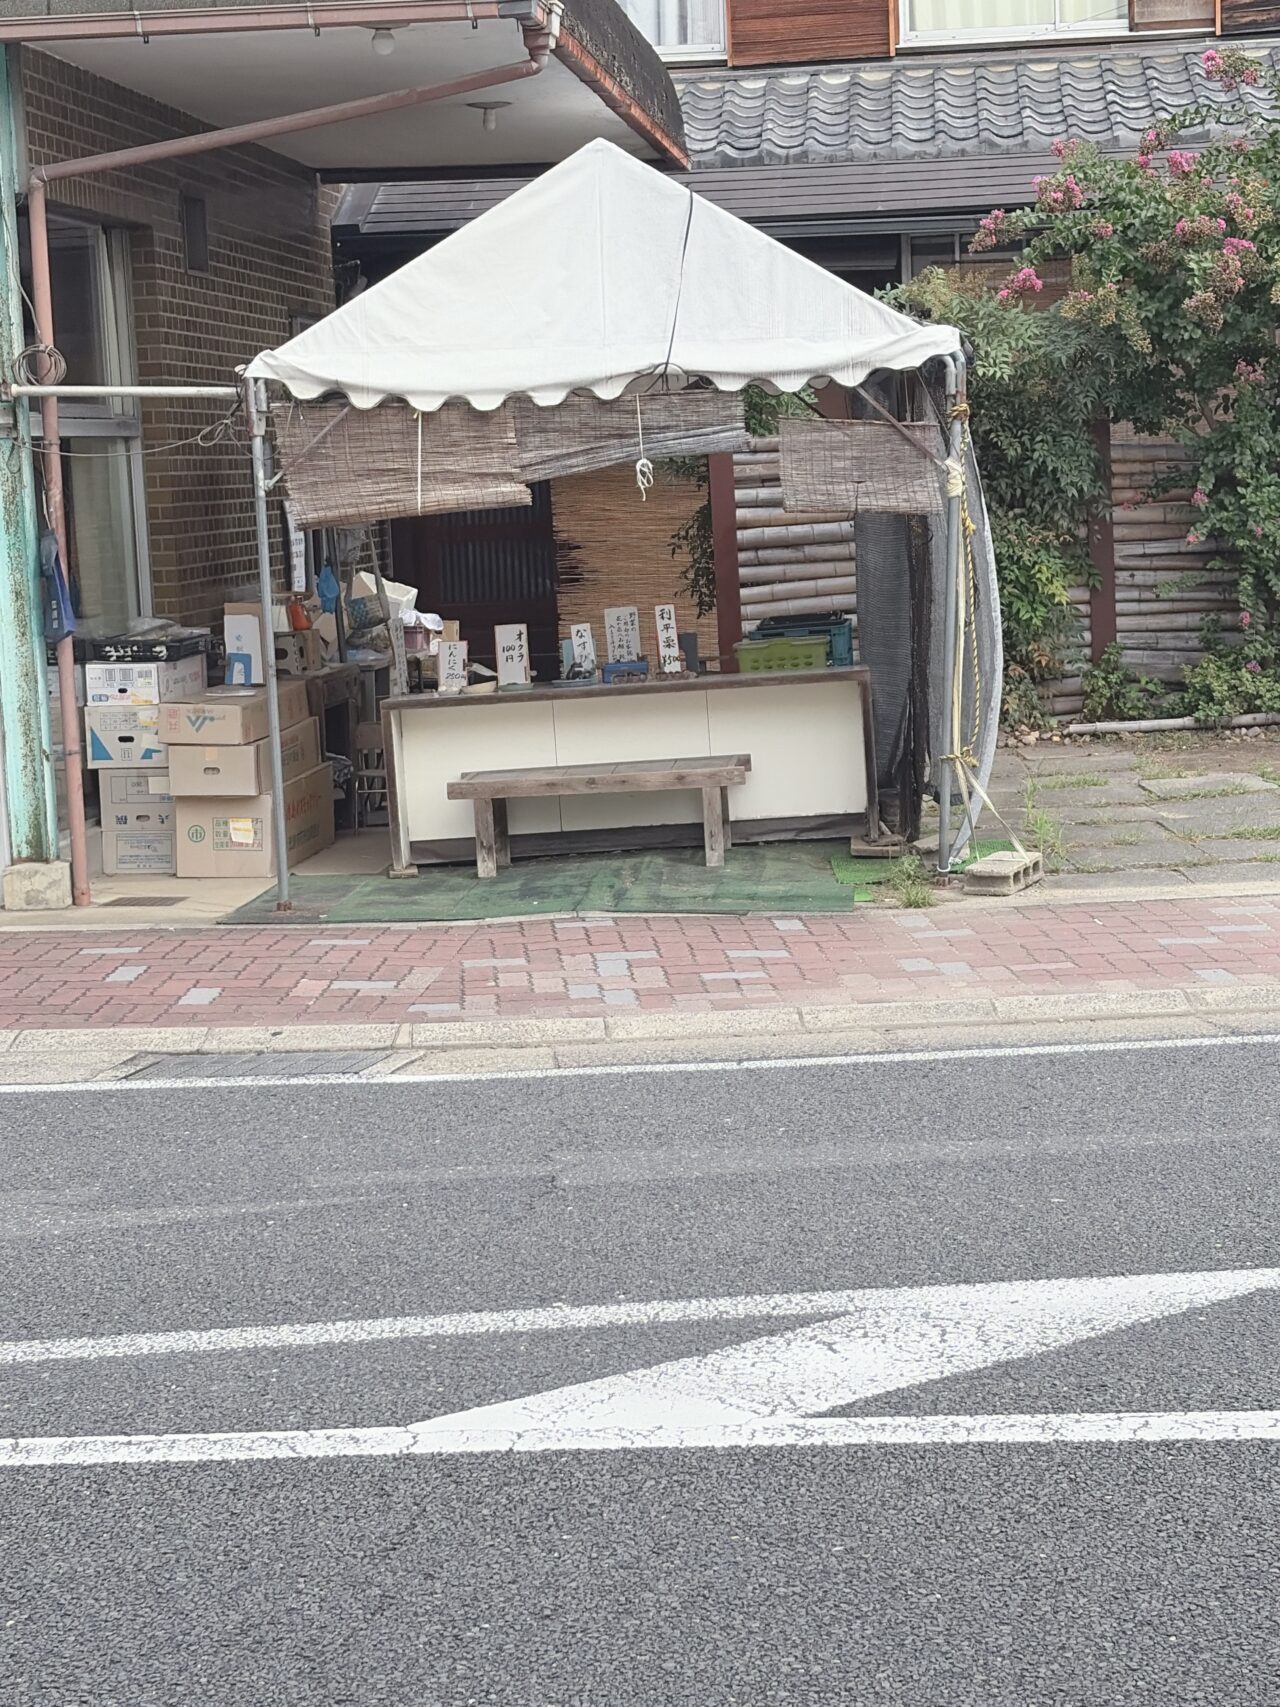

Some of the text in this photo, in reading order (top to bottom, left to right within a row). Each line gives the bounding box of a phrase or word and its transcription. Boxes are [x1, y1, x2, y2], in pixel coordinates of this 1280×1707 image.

[658, 608, 676, 649] 利平栗
[448, 643, 458, 671] にんにく
[502, 645, 516, 653] 100
[506, 655, 514, 663] 円
[515, 628, 525, 663] オクラ
